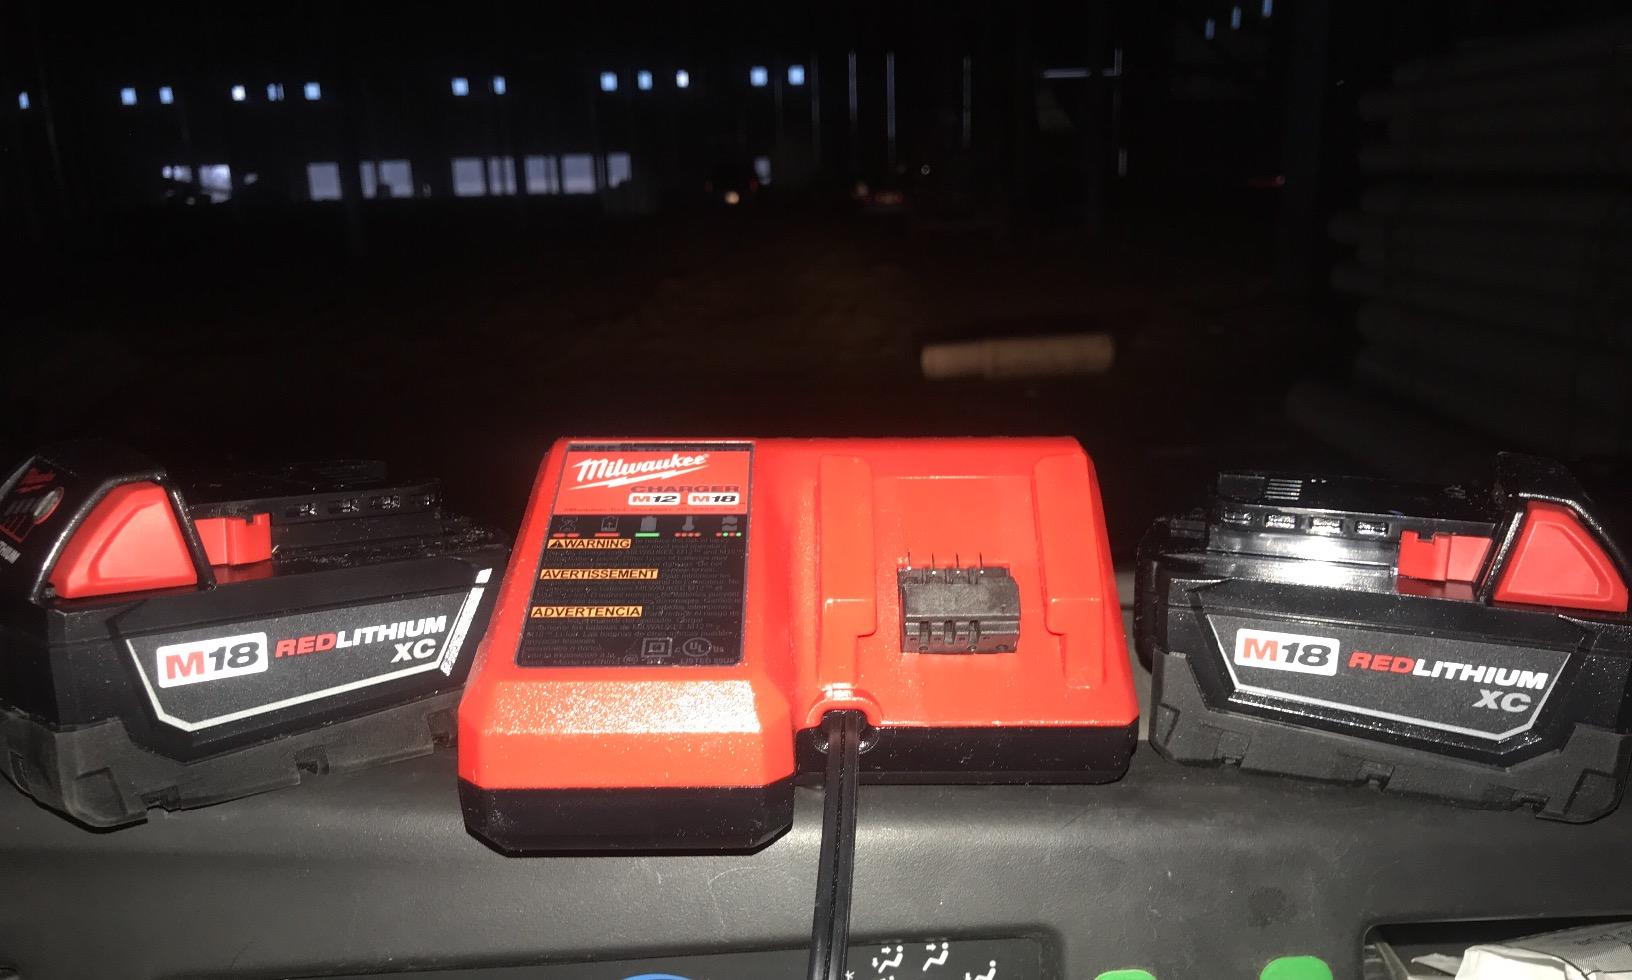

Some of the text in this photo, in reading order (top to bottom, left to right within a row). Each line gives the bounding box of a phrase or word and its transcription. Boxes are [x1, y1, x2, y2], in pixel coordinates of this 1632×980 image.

[571, 453, 706, 482] Milwaukee
[630, 485, 739, 493] CHARGER
[631, 494, 738, 503] M12 M18
[563, 539, 631, 549] WARNING
[541, 568, 658, 579] AVERTISSEMENT
[532, 606, 641, 617] ADVERTENCIA
[165, 614, 447, 679] M18 REDLITHIUM
[390, 637, 437, 664] XC
[1242, 637, 1549, 690] M18 REDLITHIUM
[1472, 688, 1532, 713] XC
